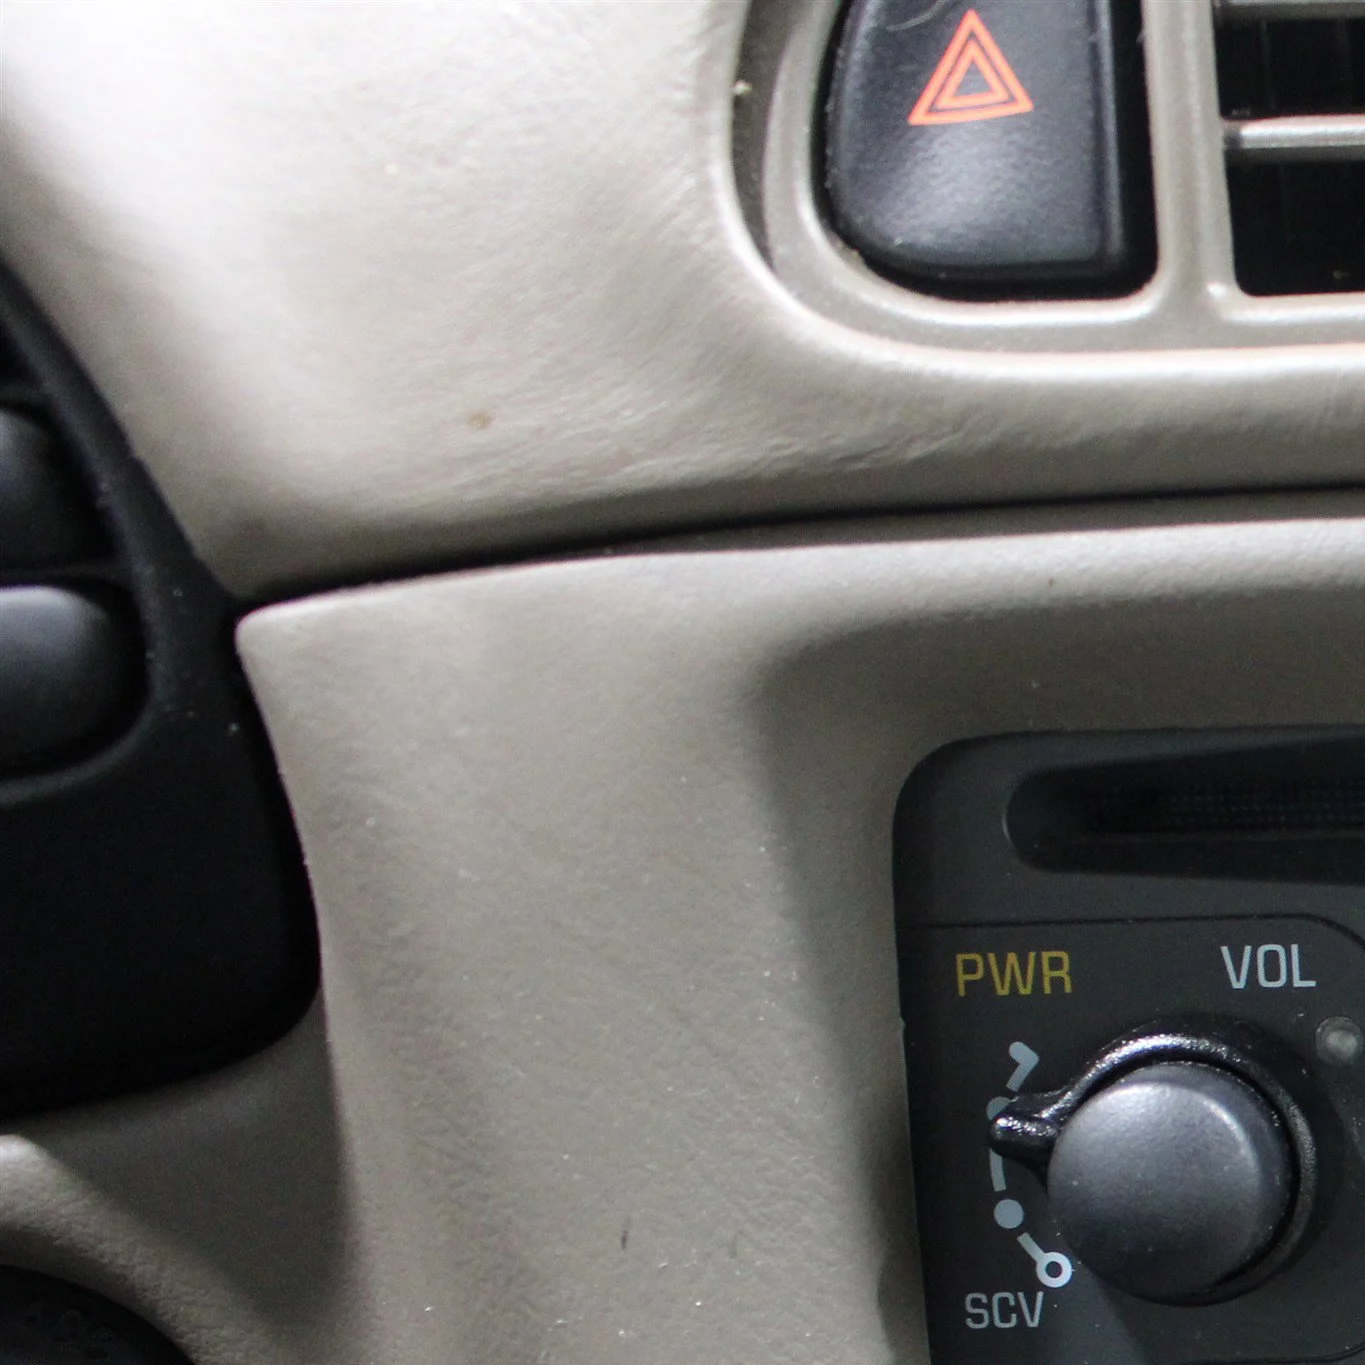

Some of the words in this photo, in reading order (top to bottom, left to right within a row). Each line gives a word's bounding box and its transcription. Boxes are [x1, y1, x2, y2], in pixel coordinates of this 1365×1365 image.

[956, 950, 1072, 996] PWR
[1220, 943, 1317, 990] VOL
[965, 1290, 1045, 1329] SCV
